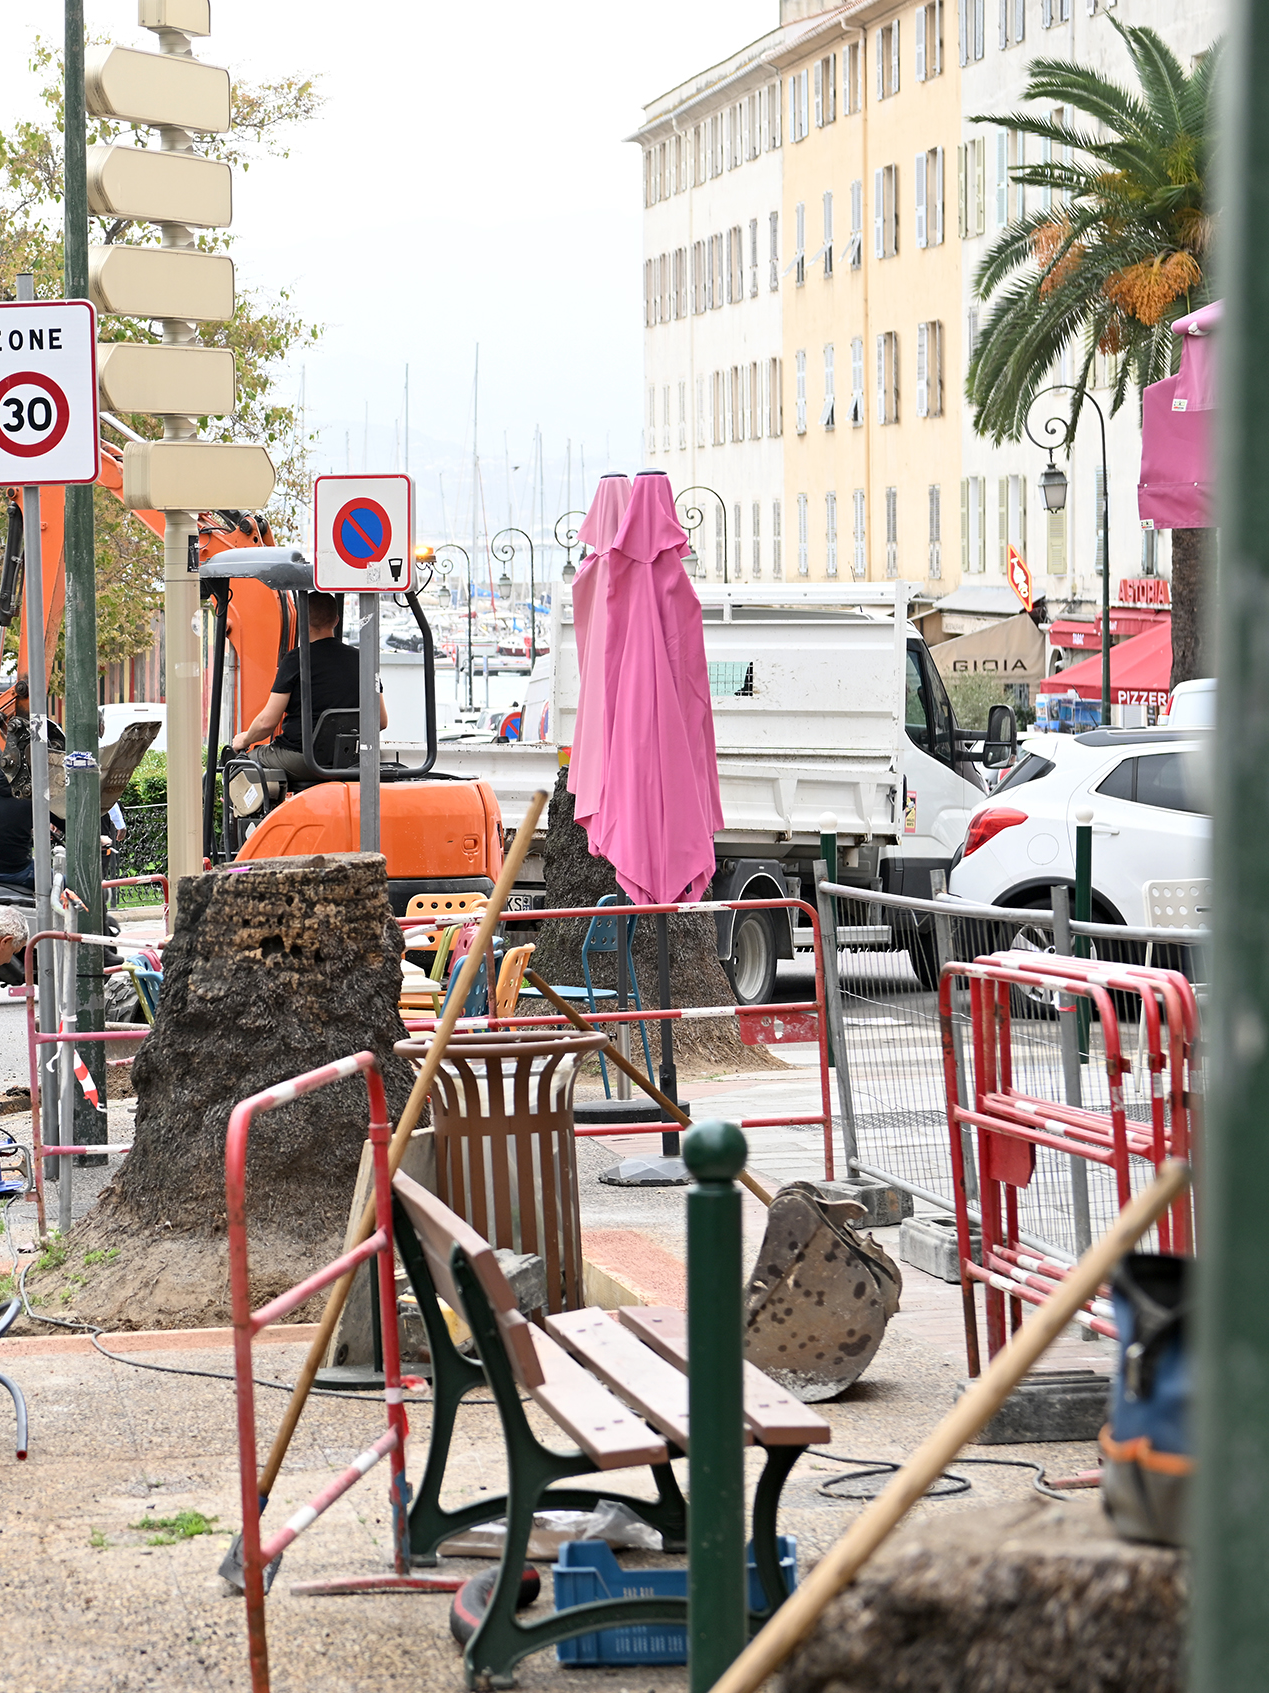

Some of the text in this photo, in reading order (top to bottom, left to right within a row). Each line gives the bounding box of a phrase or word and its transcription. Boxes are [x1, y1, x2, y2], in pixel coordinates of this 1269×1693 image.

[2, 396, 53, 432] 30
[1118, 579, 1167, 604] ASTORIA
[953, 659, 1027, 672] GIOIA
[1118, 690, 1170, 706] PIZZER
